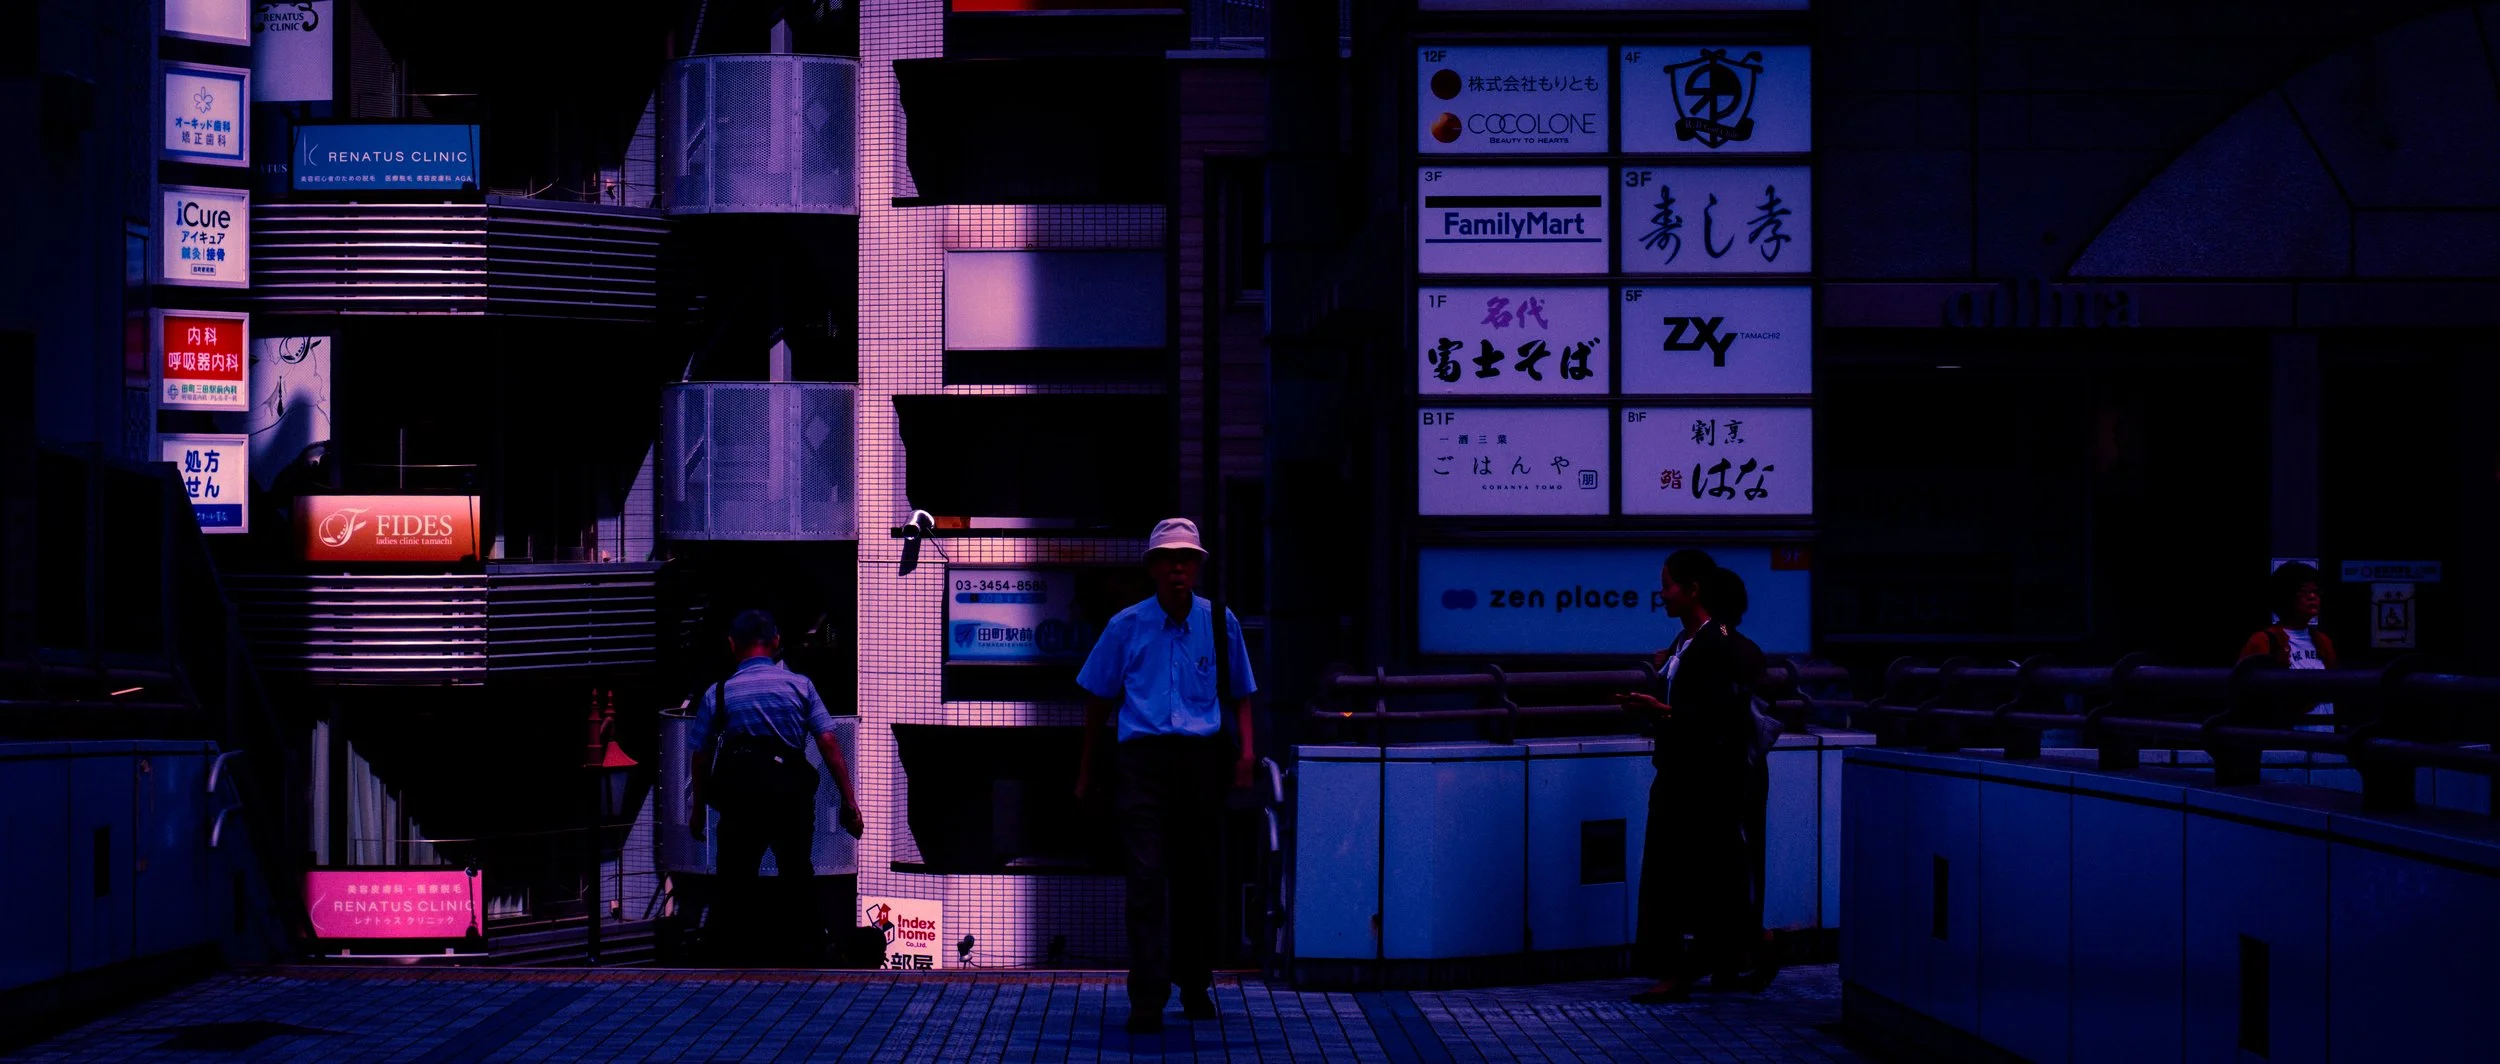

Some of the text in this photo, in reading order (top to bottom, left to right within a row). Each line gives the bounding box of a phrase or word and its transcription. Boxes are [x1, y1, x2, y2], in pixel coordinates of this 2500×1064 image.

[263, 12, 305, 22] RENATUS
[270, 22, 300, 32] CLINIC
[1423, 51, 1447, 62] 12F
[1624, 52, 1641, 63] 4F
[1468, 75, 1599, 92] 株式会社もりとも
[175, 117, 231, 132] オーキッド歯科
[1468, 113, 1596, 134] COCOLONE
[181, 131, 226, 147] 矯正歯科
[328, 151, 468, 163] RENATUS CLINIC
[1424, 171, 1443, 182] 3F
[1625, 172, 1652, 187] 3F
[176, 200, 231, 229] iCure
[1444, 211, 1585, 238] FamilyMart
[181, 230, 225, 245] アイキュア
[1428, 295, 1447, 308] 1F
[1625, 290, 1643, 301] 5F
[1480, 296, 1548, 330] 名代
[187, 326, 218, 347] 内科
[1663, 316, 1738, 367] ZXY
[168, 351, 239, 373] 呼吸器内科
[1428, 337, 1601, 383] 富士そば
[1423, 412, 1455, 425] B1F
[1628, 412, 1647, 423] B1F
[1691, 419, 1744, 446] 割烹
[185, 449, 220, 473] 処方
[1433, 455, 1570, 476] ごはんや
[1691, 457, 1775, 501] はな
[186, 476, 220, 498] せん
[375, 514, 453, 537] FIDES
[375, 536, 453, 545] ladies clinic tamachi
[1490, 587, 1545, 608] zen
[1556, 585, 1640, 614] place
[977, 627, 1033, 642] 田町駅前
[334, 900, 475, 913] RENATUS CLINIC
[406, 916, 455, 926] クリニック
[898, 928, 936, 941] home
